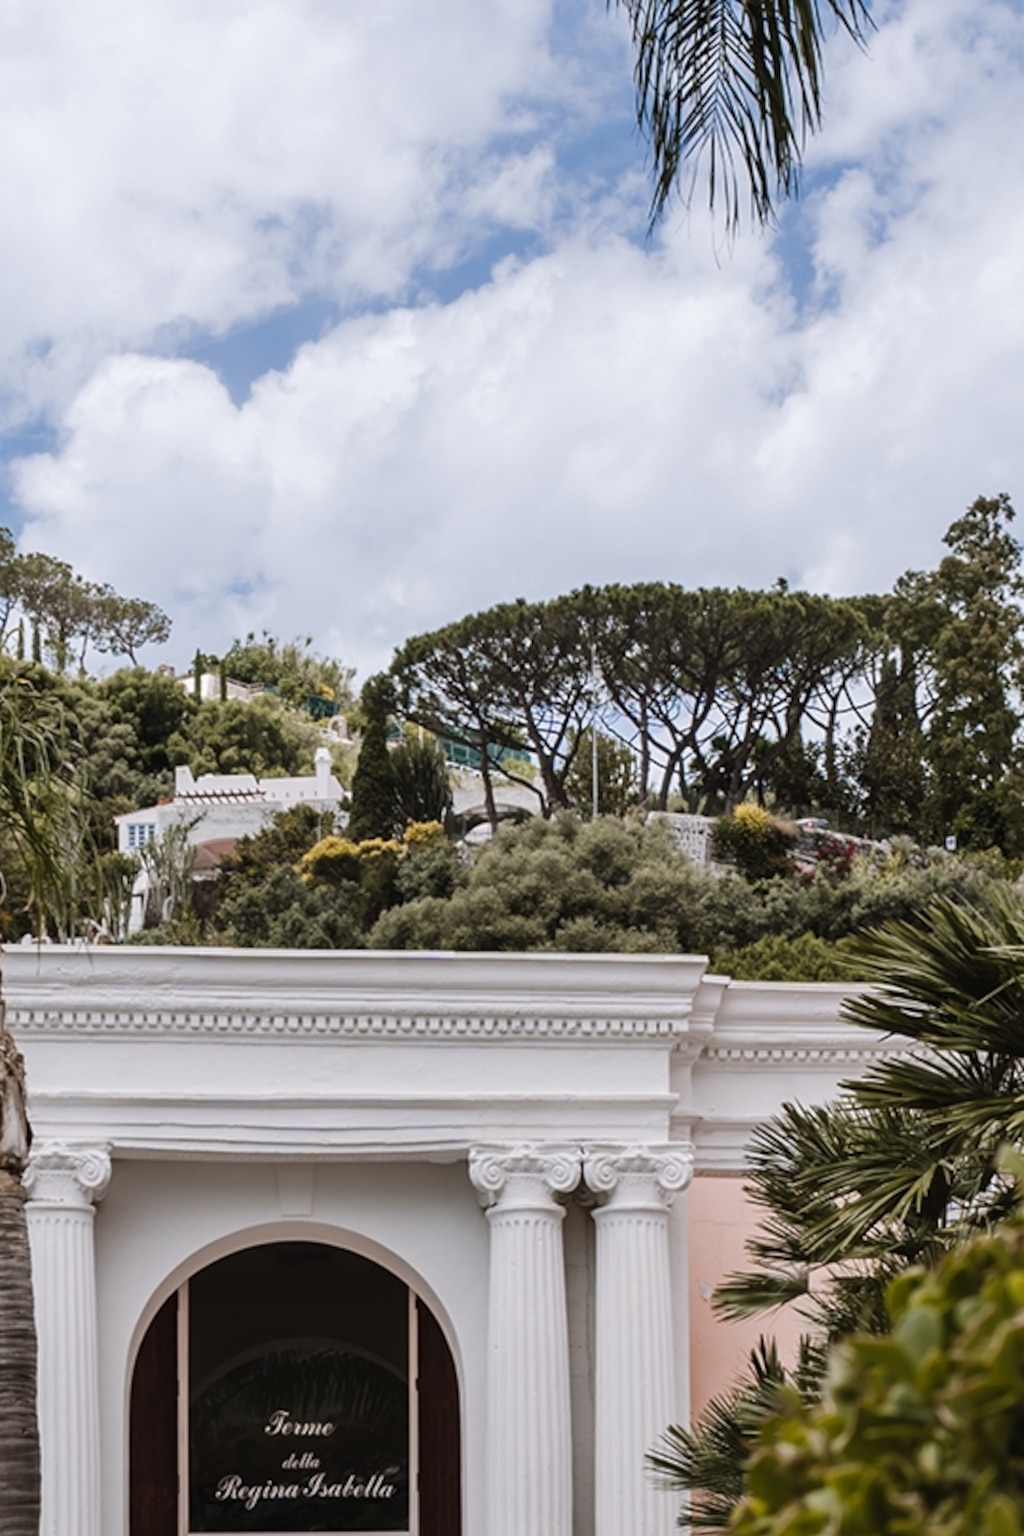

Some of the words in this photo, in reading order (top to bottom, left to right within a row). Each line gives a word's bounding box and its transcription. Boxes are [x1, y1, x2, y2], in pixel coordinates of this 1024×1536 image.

[264, 1409, 335, 1437] Terme
[281, 1453, 321, 1470] della
[215, 1474, 302, 1511] Regina
[303, 1472, 396, 1499] Isabella
